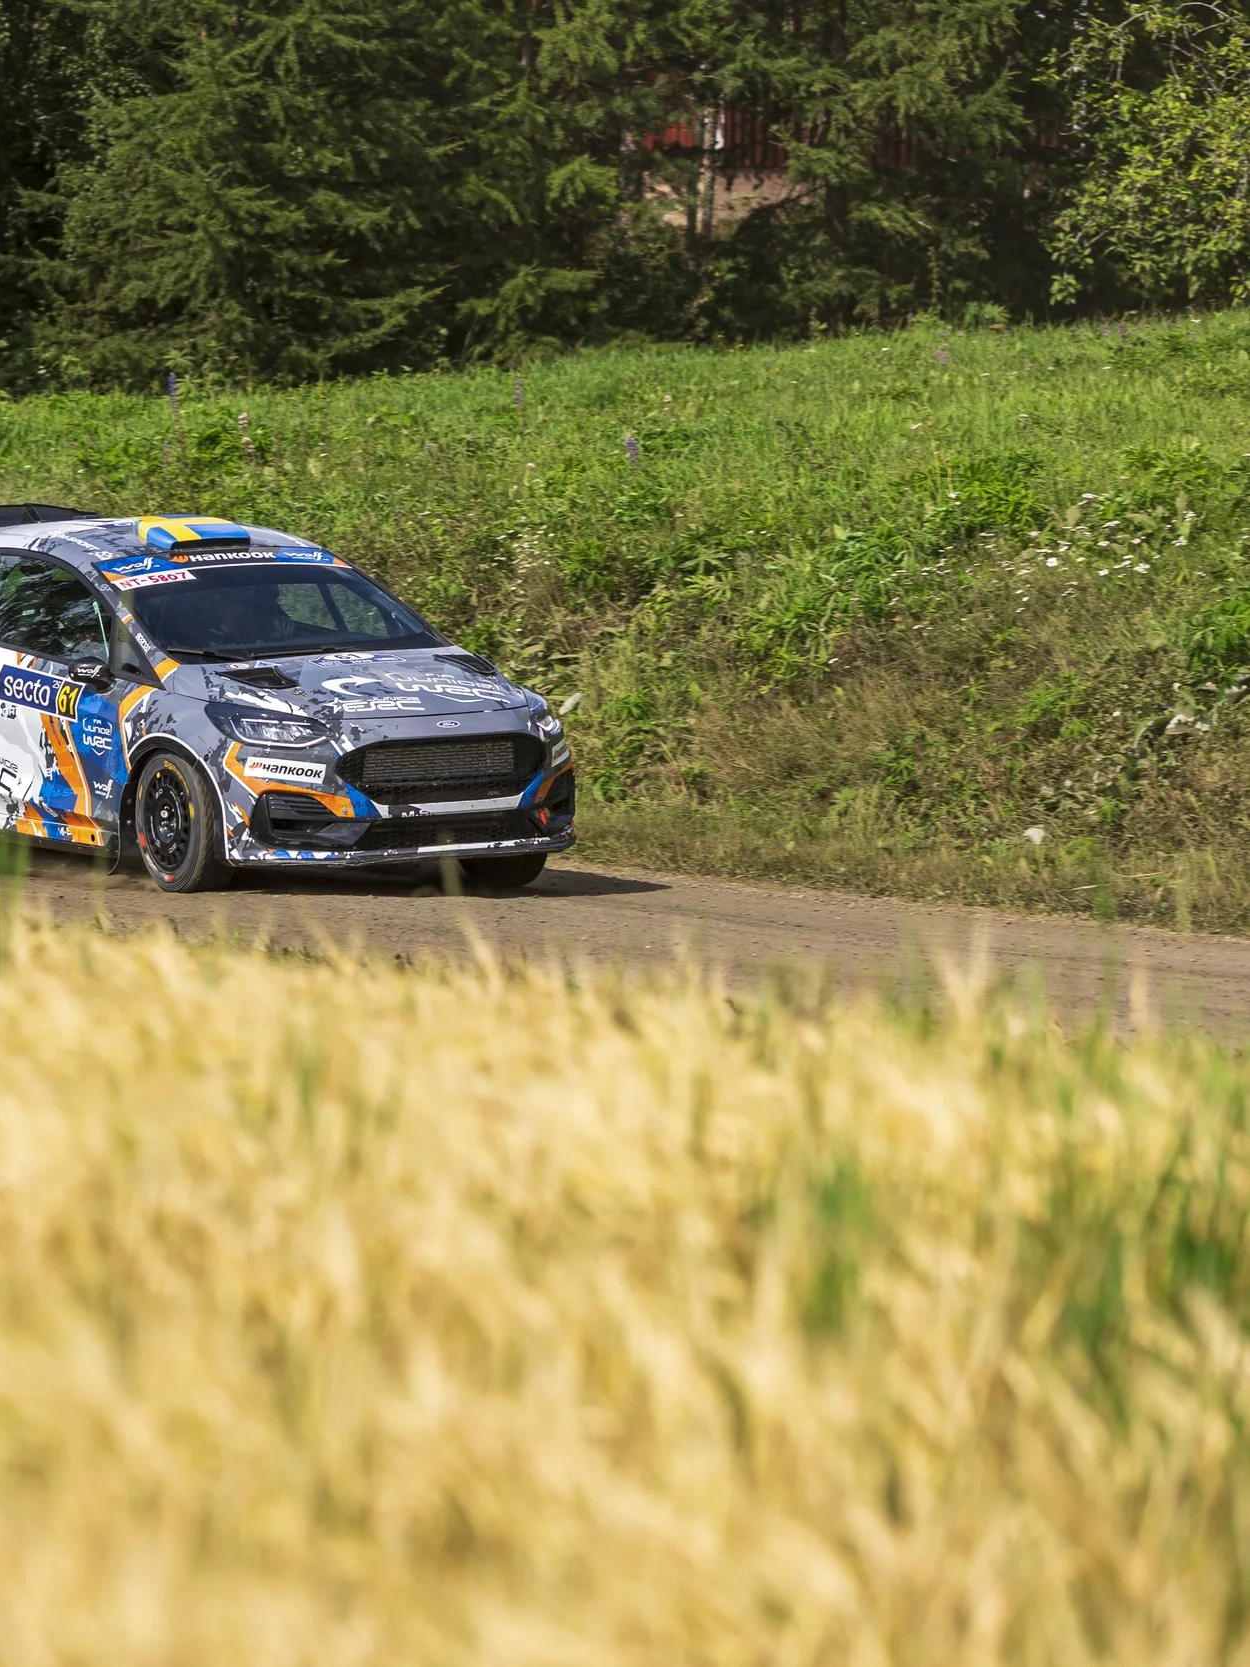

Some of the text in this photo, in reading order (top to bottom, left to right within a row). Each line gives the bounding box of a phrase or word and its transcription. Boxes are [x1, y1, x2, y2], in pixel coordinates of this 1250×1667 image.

[111, 557, 154, 573] wolf
[119, 571, 187, 589] NT-5807
[77, 665, 102, 678] wolf
[3, 675, 51, 706] secto
[395, 682, 510, 704] WRC
[58, 685, 79, 715] 61
[83, 733, 113, 750] WRC
